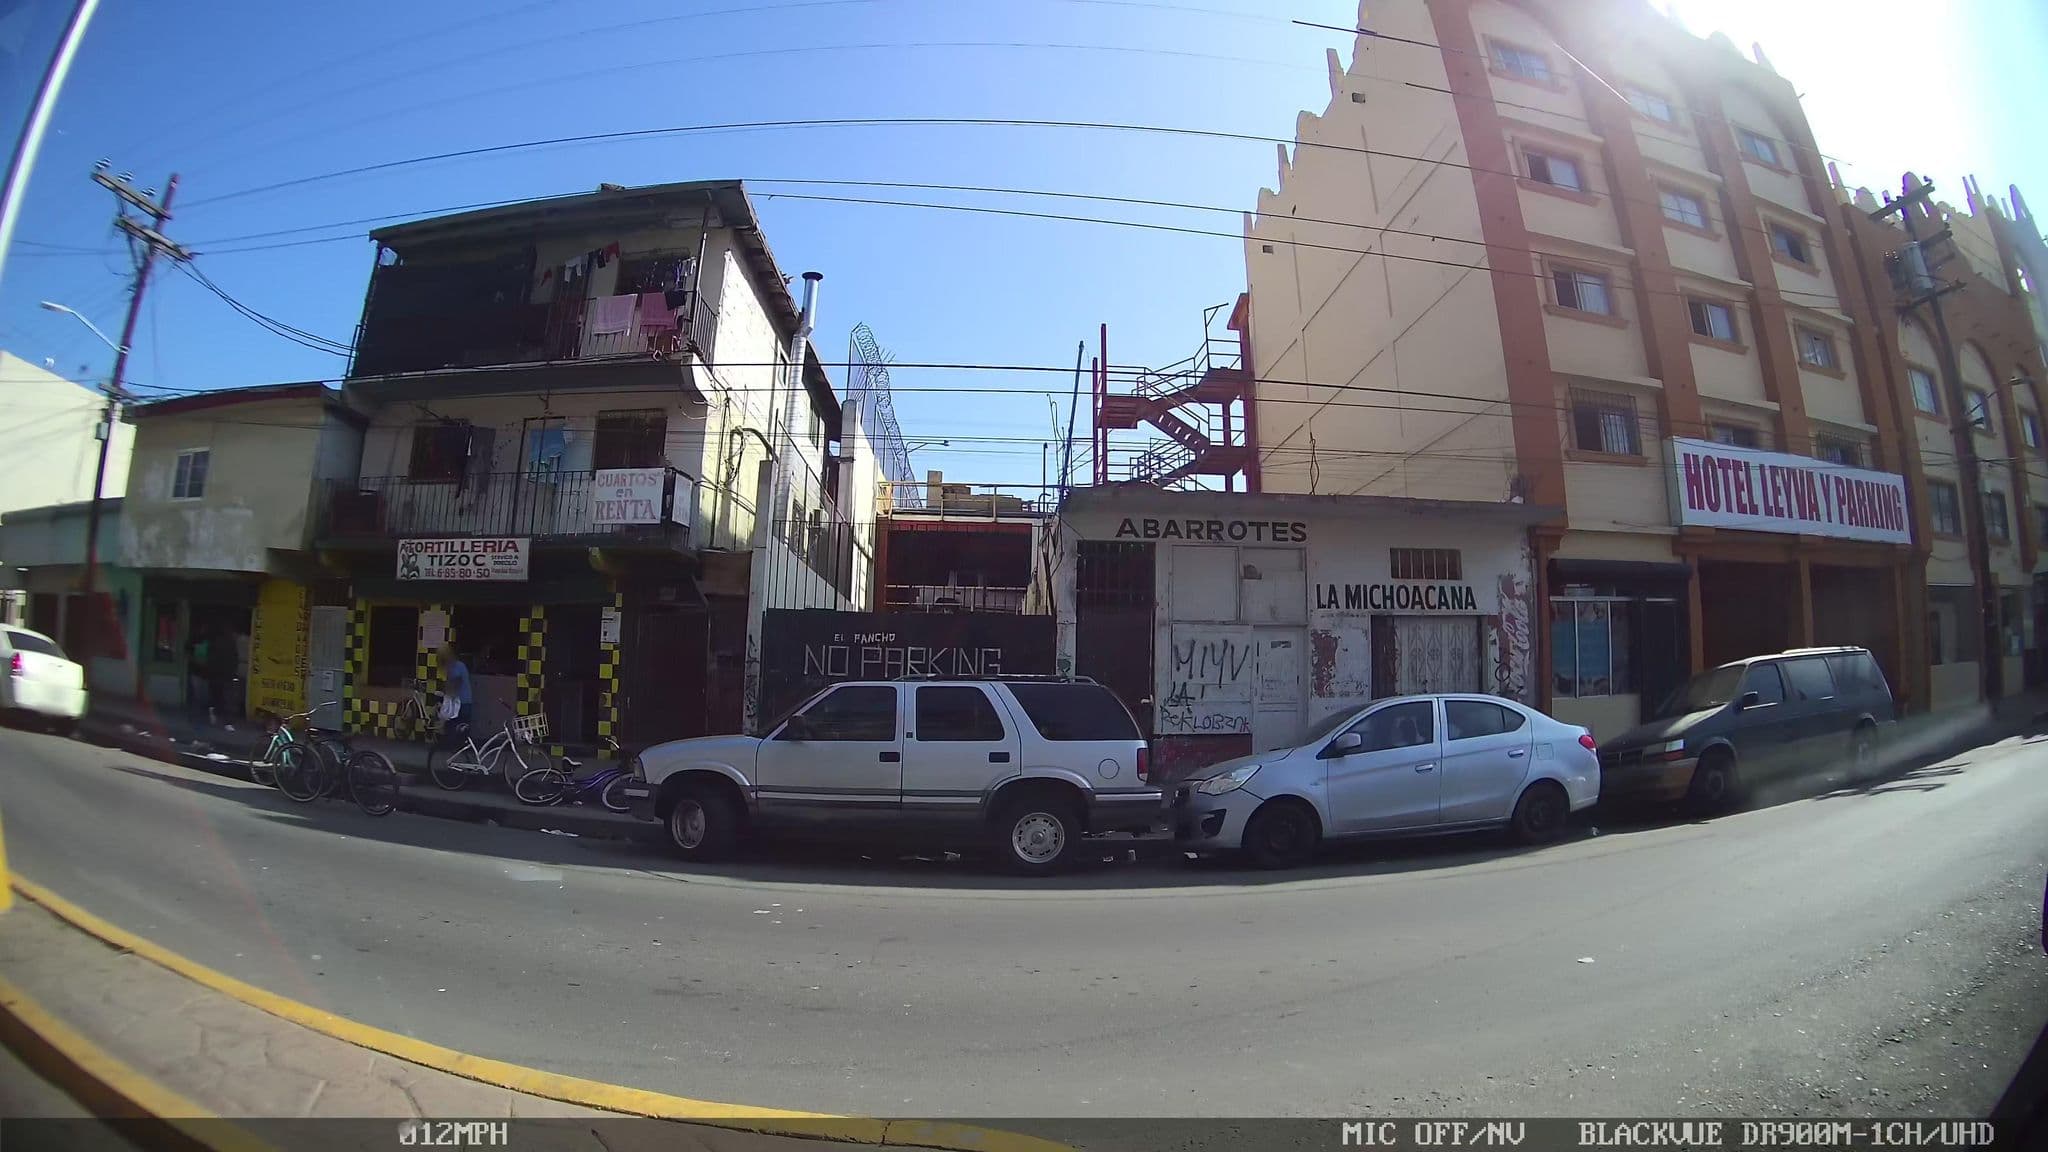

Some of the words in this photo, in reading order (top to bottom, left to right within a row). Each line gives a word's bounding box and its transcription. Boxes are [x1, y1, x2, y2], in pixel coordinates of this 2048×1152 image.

[597, 472, 657, 488] CUARTOS
[615, 488, 633, 498] en
[1682, 452, 1760, 516] HOTEL
[1760, 463, 1821, 522] LEYVA
[1818, 470, 1835, 523] Y
[1836, 475, 1904, 532] PARKING
[595, 499, 657, 521] RENTA
[1115, 517, 1307, 543] ABARROTES
[405, 540, 519, 554] TORTILLERIA
[428, 554, 487, 567] TIZOC
[1315, 582, 1340, 610] LA
[1345, 583, 1477, 611] MICHOACANA
[854, 632, 896, 643] PANCHO
[803, 644, 849, 677] NO
[861, 645, 1001, 678] PARKING
